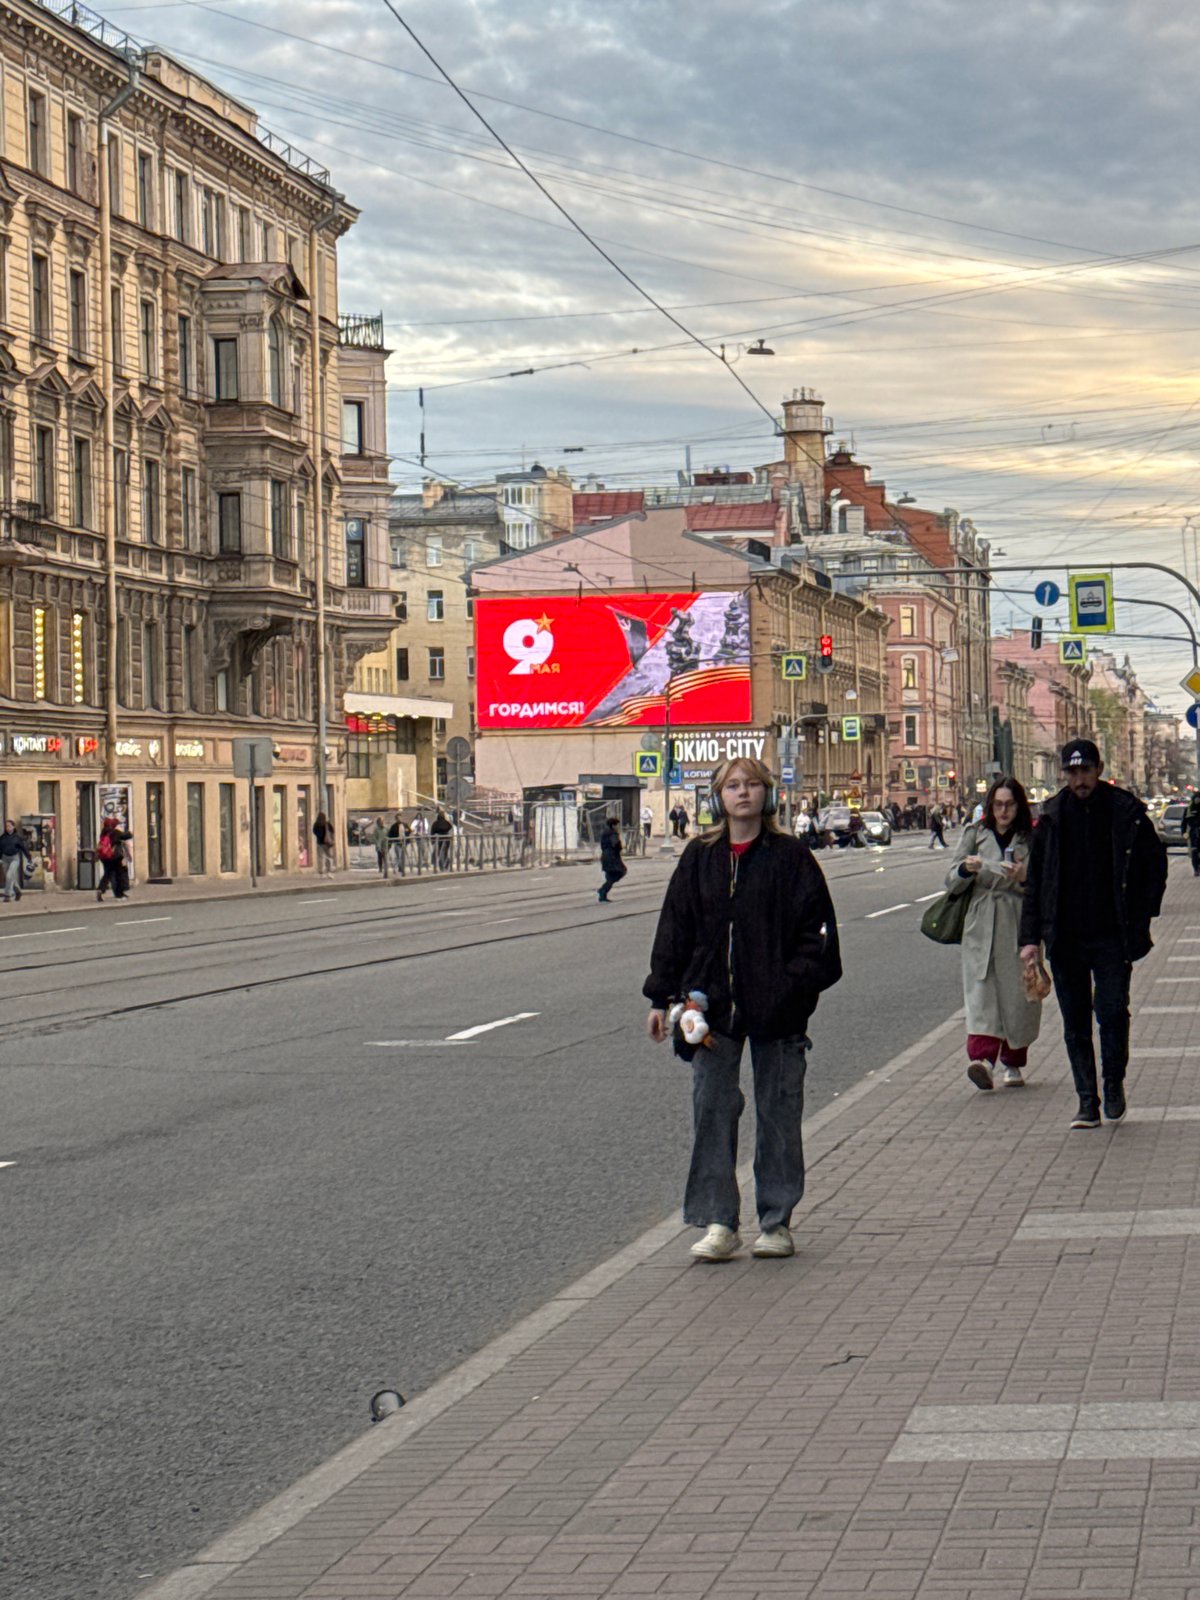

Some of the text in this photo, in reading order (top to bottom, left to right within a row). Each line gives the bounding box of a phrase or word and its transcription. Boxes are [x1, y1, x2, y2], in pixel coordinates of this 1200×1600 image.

[502, 618, 560, 675] 9 МАЯ
[489, 701, 584, 718] ГОРДИМСЯ!
